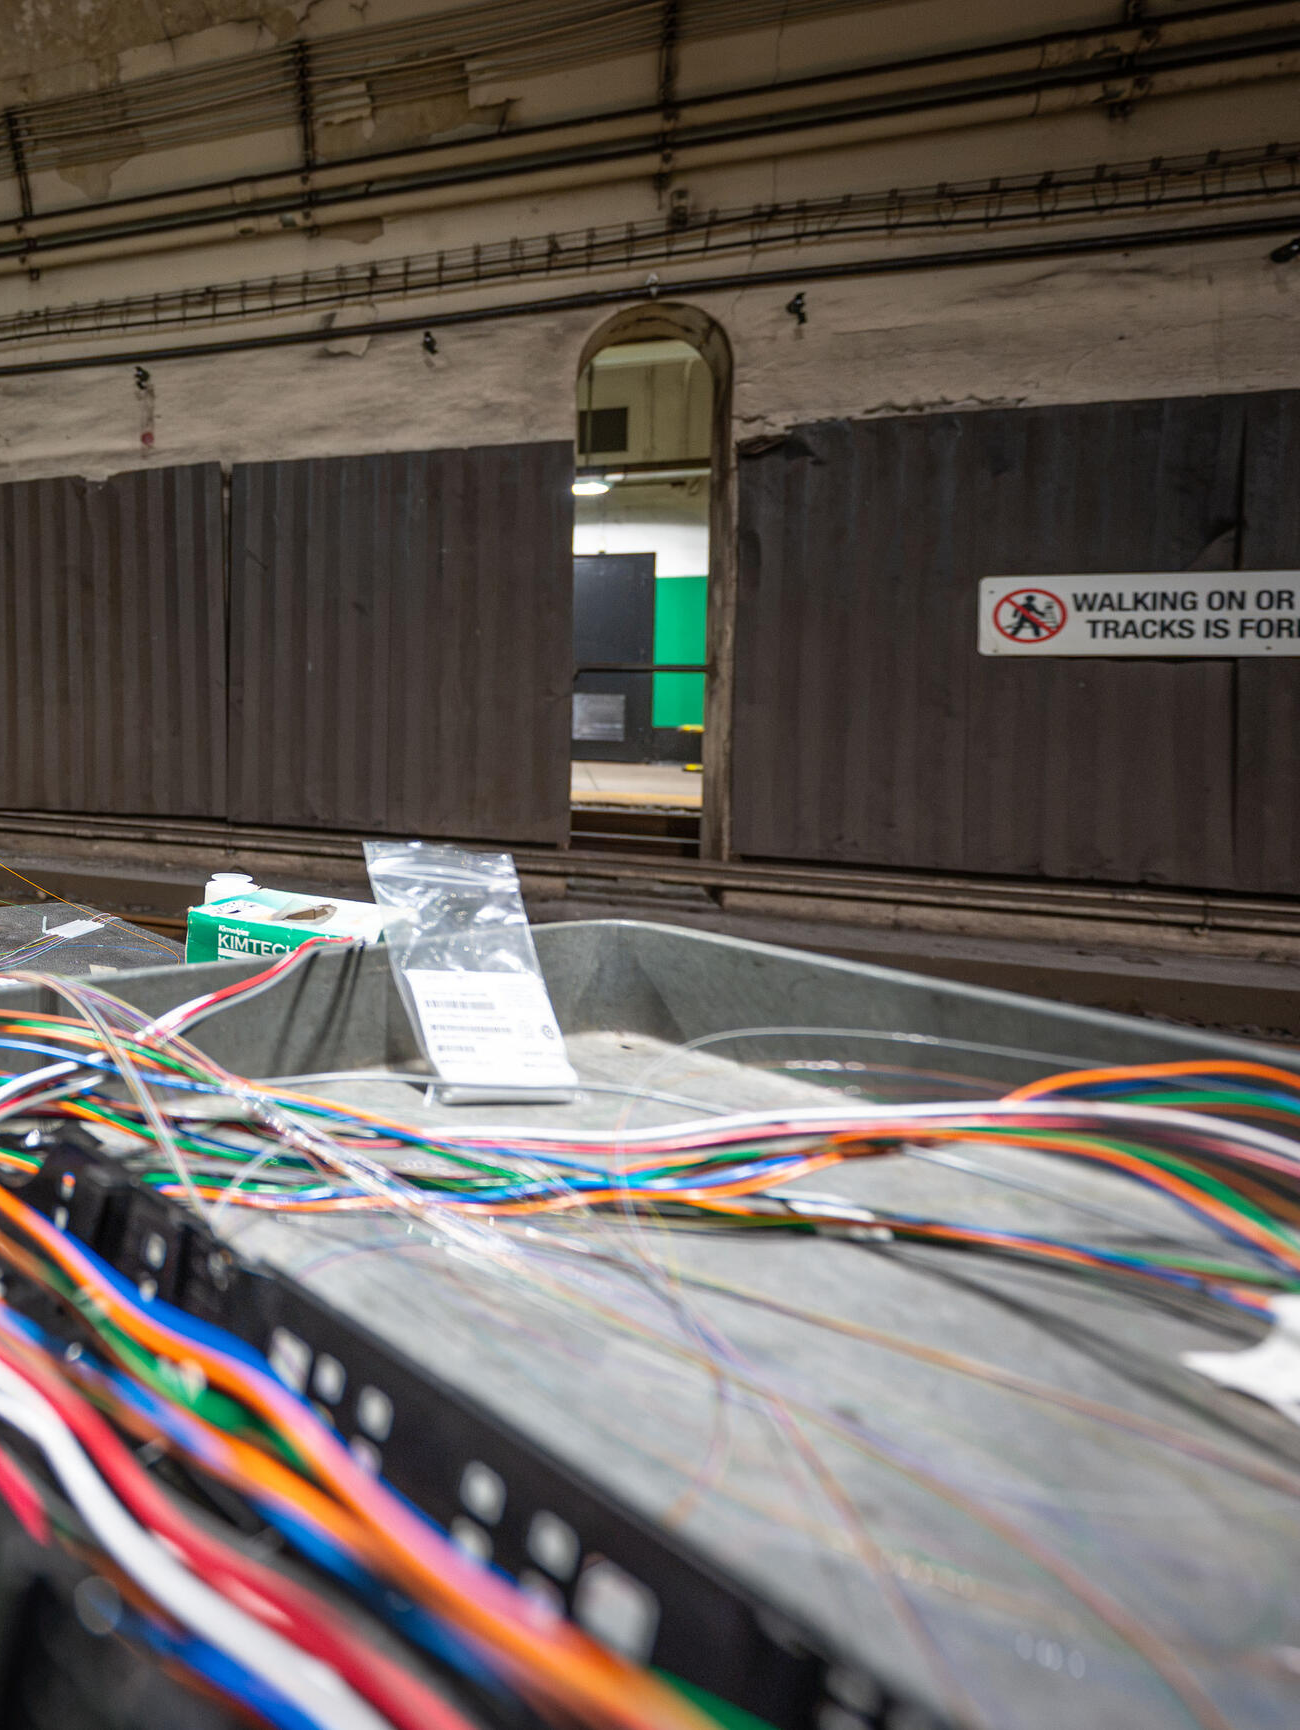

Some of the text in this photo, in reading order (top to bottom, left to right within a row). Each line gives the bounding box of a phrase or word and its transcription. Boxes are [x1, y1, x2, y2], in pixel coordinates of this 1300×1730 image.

[1072, 590, 1295, 612] WALKING ON OR
[1086, 618, 1300, 639] TRACKS IS FOR
